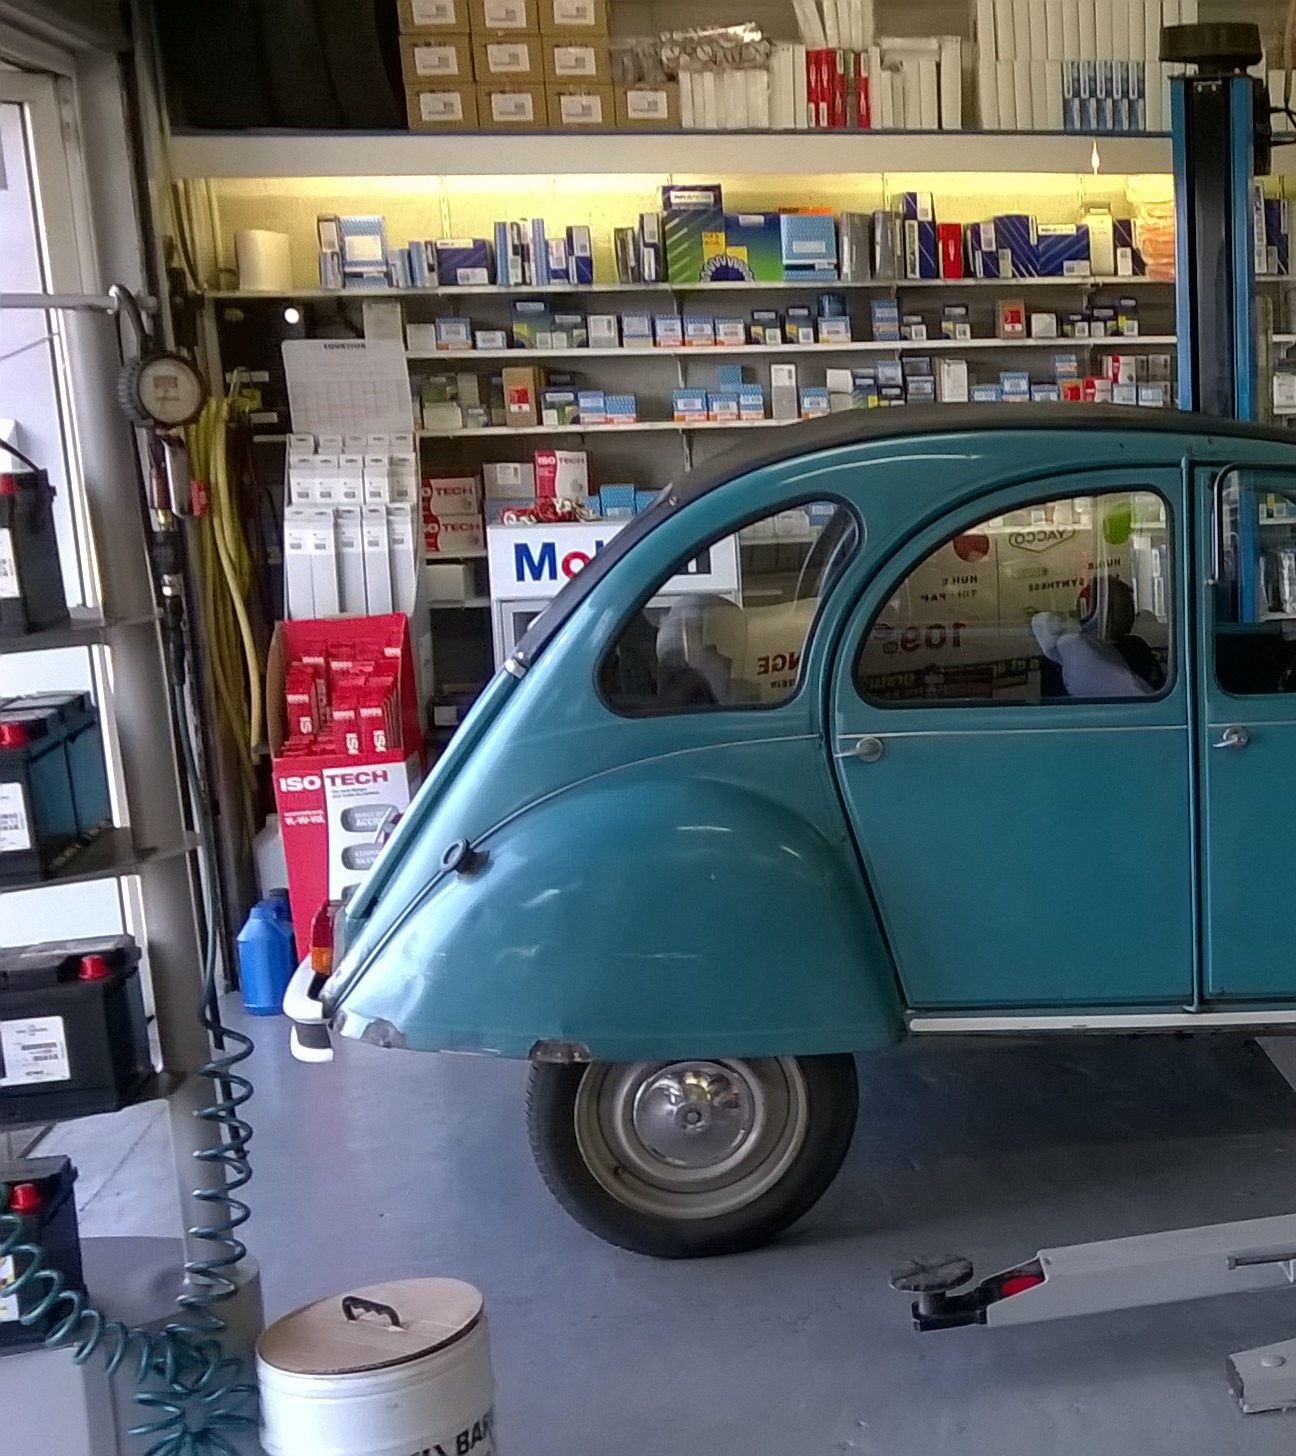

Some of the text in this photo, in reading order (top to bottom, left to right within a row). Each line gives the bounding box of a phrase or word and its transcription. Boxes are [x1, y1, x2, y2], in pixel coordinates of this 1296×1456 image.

[558, 456, 585, 464] TECH
[435, 487, 473, 496] TECH
[441, 522, 480, 533] TECH
[279, 775, 322, 793] ISO
[325, 769, 389, 787] TECH
